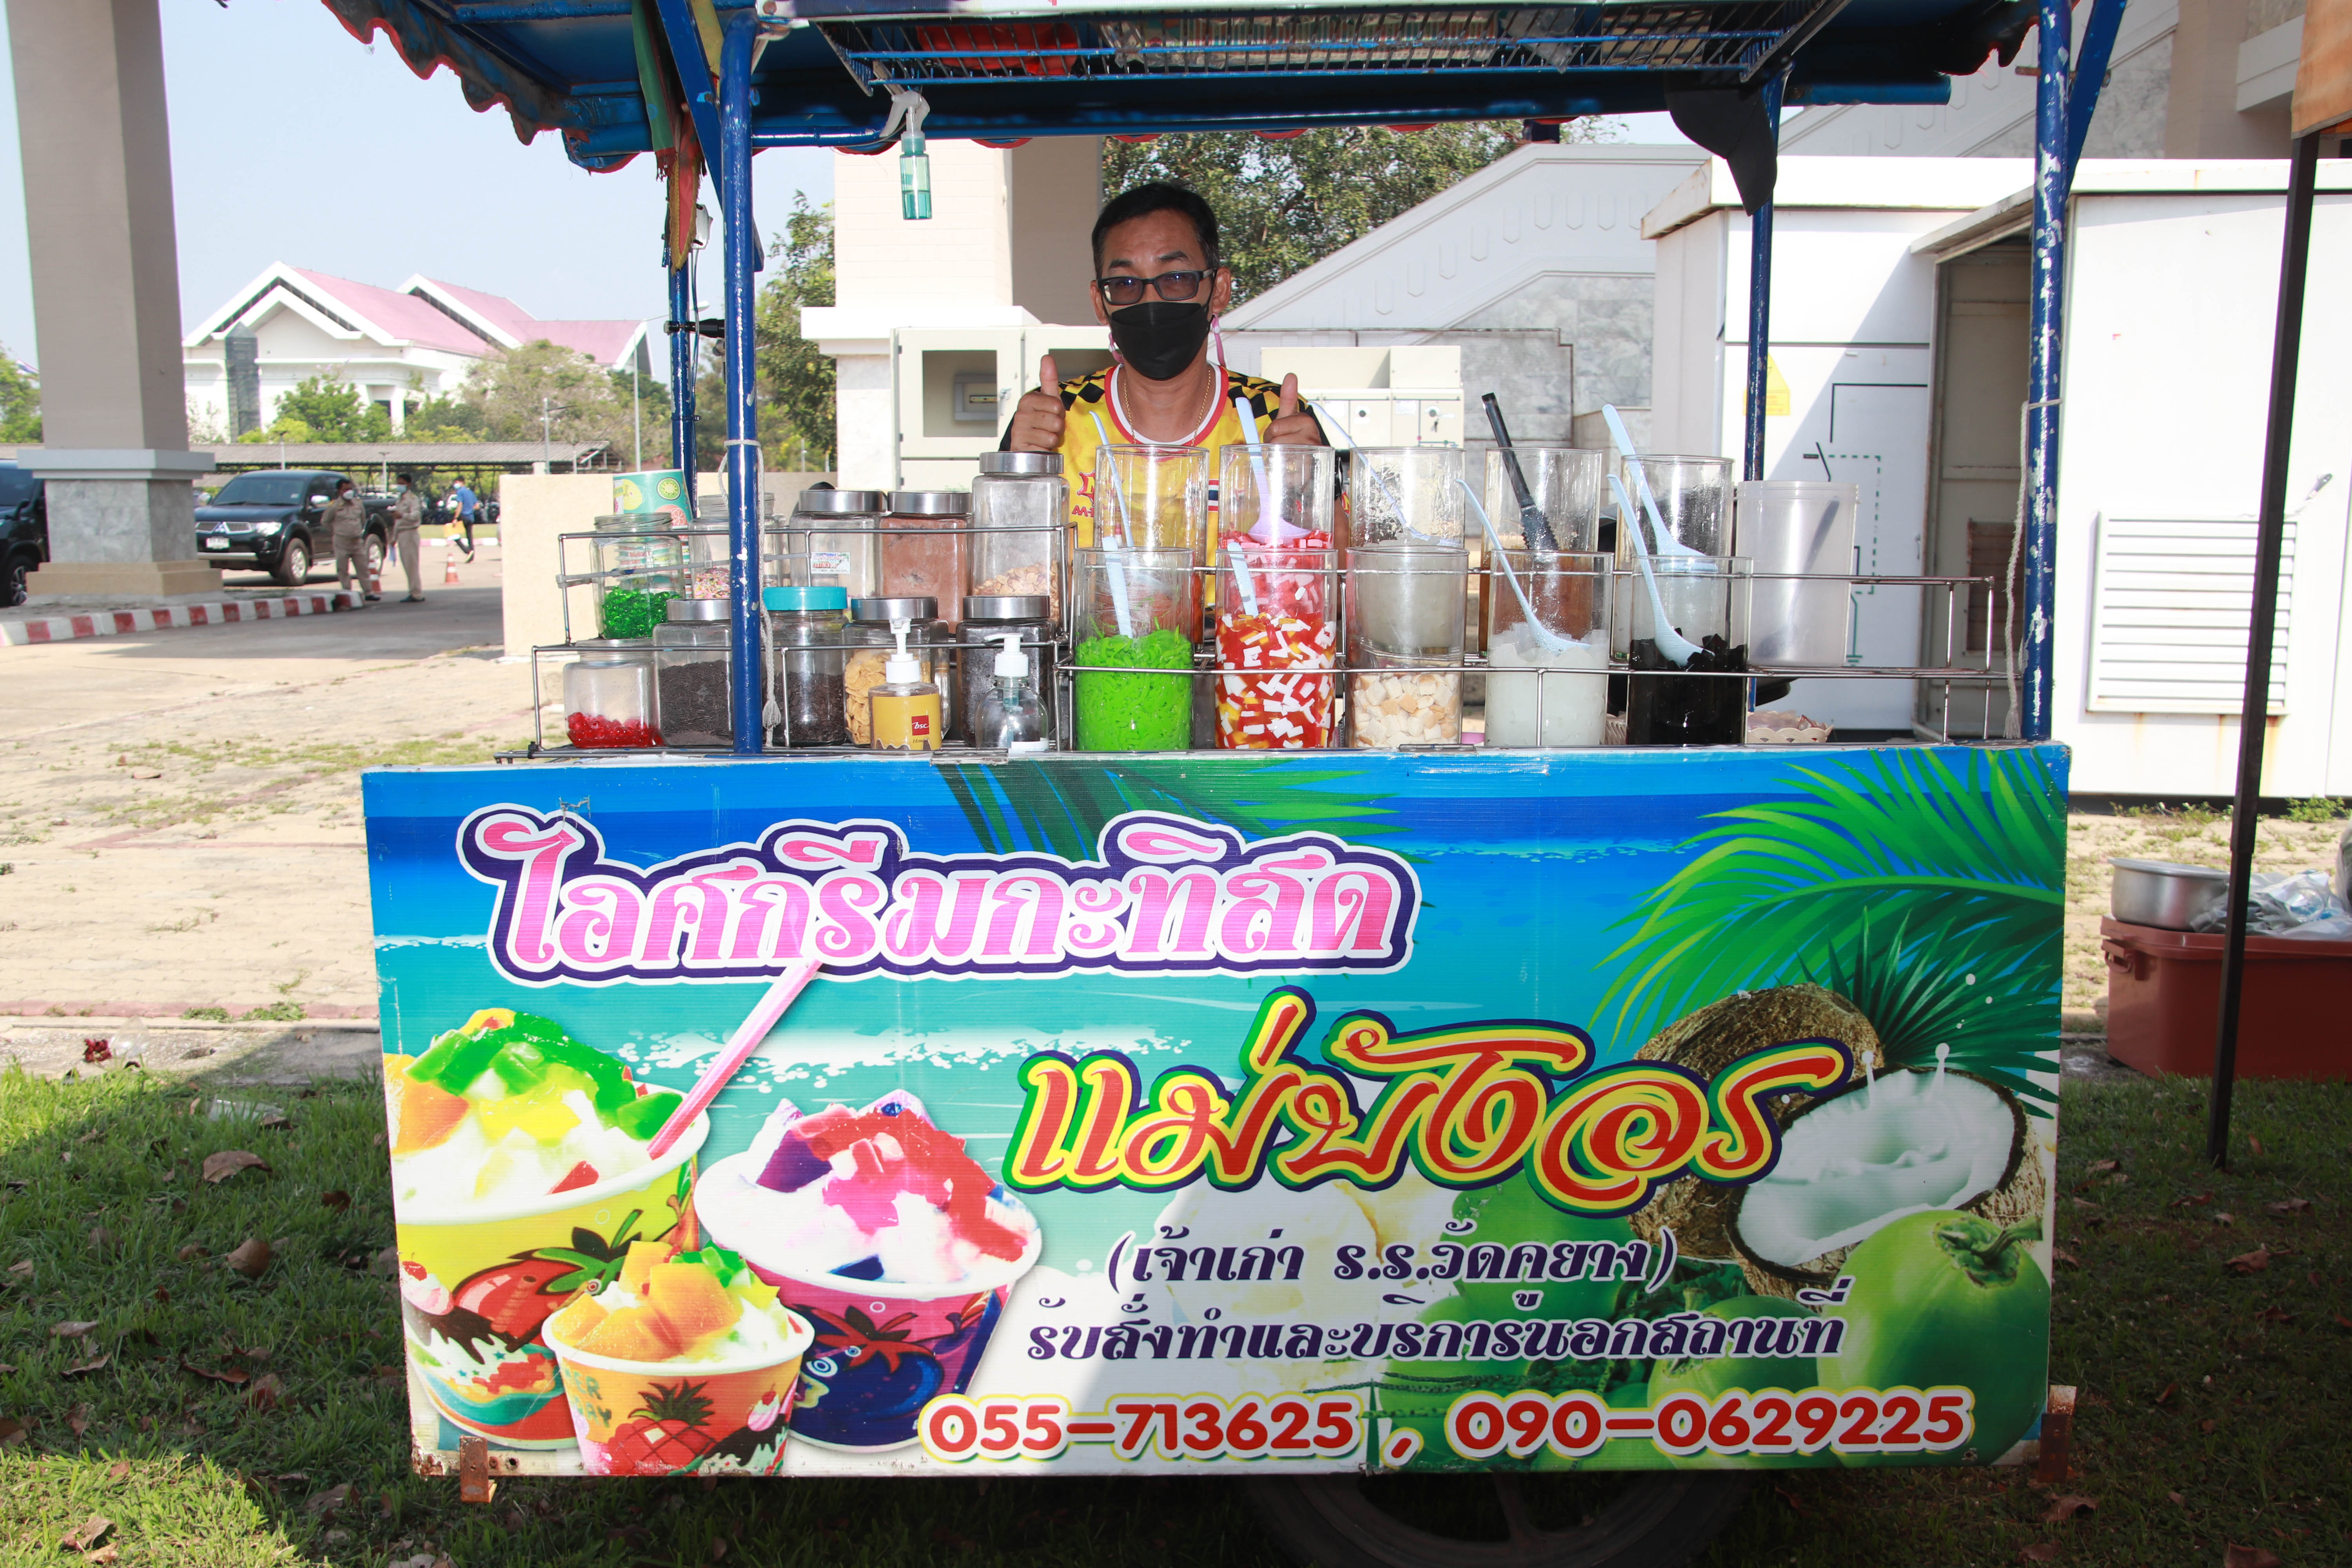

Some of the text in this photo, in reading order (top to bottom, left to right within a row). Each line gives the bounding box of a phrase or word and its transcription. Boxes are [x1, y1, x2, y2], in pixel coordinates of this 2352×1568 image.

[481, 819, 1394, 965] ไอศกรีมกะทิสด
[1109, 1226, 1304, 1293] (เจ้าเก่า
[1028, 1279, 1852, 1359] รับสั่งทำและบริการนอกสถานที่
[1455, 1396, 1964, 1450] 090-0629225
